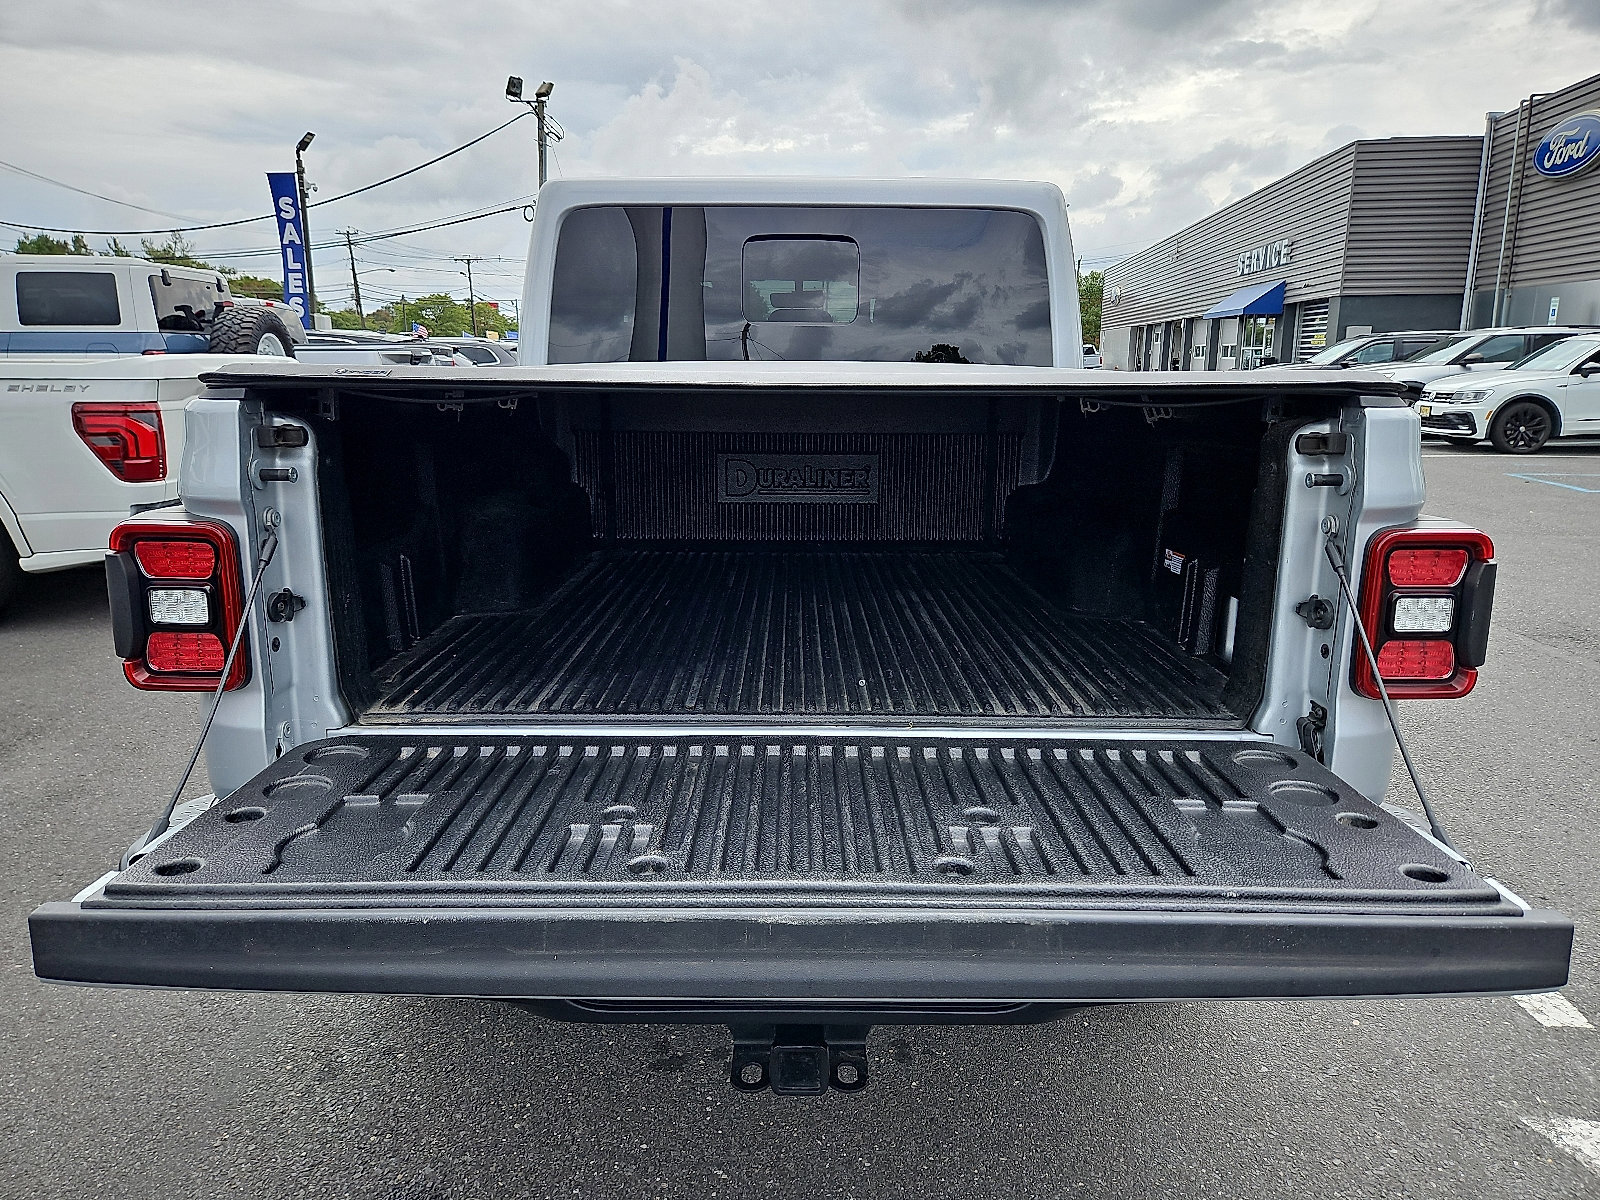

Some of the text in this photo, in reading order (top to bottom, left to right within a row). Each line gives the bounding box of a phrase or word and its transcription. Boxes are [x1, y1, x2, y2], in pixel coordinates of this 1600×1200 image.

[1544, 126, 1591, 168] Ford
[278, 196, 305, 318] SALES
[1236, 238, 1292, 276] SERVICE
[6, 384, 91, 393] SHELBY
